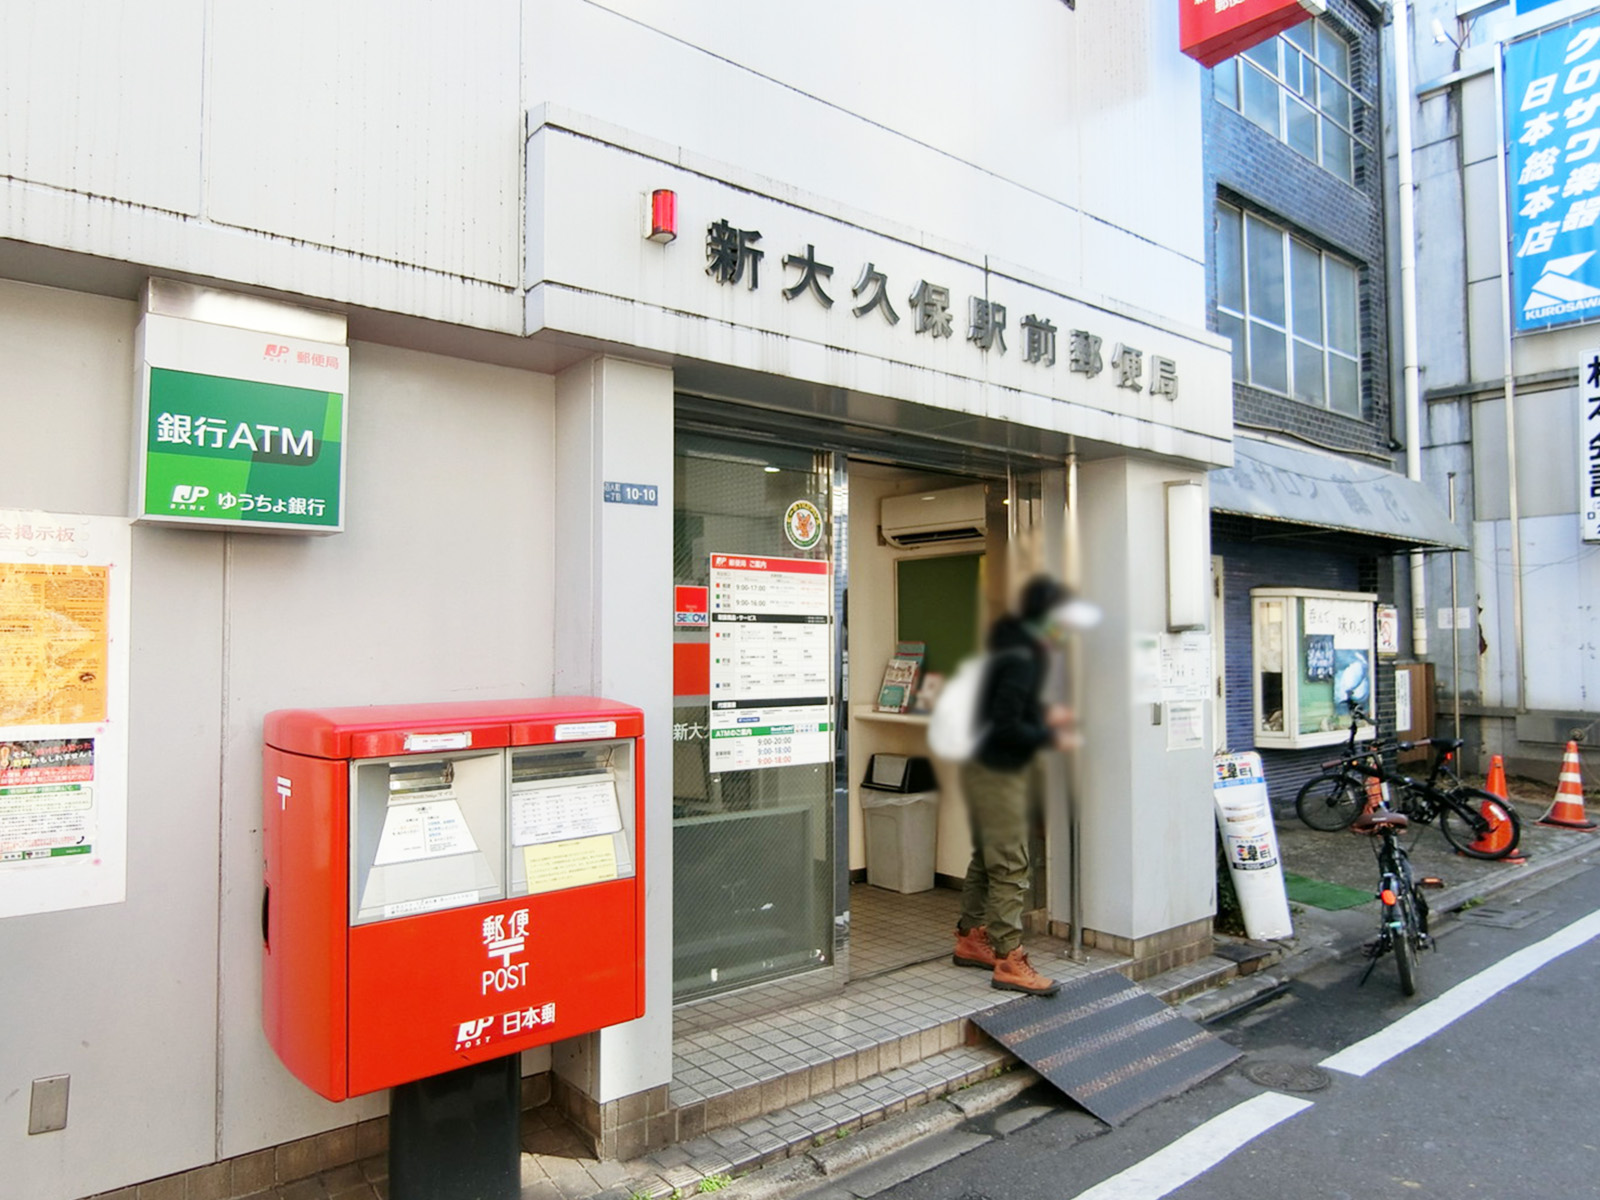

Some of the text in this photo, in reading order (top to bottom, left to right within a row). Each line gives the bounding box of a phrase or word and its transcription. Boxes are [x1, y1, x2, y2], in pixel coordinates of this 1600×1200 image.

[1516, 73, 1562, 259] 日本総本店
[704, 218, 1179, 402] 新大久保駅前郵便局
[296, 351, 340, 370] 郵便局
[156, 412, 314, 458] 銀行ATM
[169, 503, 206, 512] BANK
[171, 484, 326, 517] JP ゆうちょ銀行
[626, 487, 656, 502] 10-10
[676, 612, 707, 623] SECOM
[757, 736, 792, 746] 9:00-20:00
[482, 908, 530, 945] 郵便
[482, 962, 530, 996] POST
[455, 1035, 491, 1051] POST
[456, 1016, 494, 1043] JP
